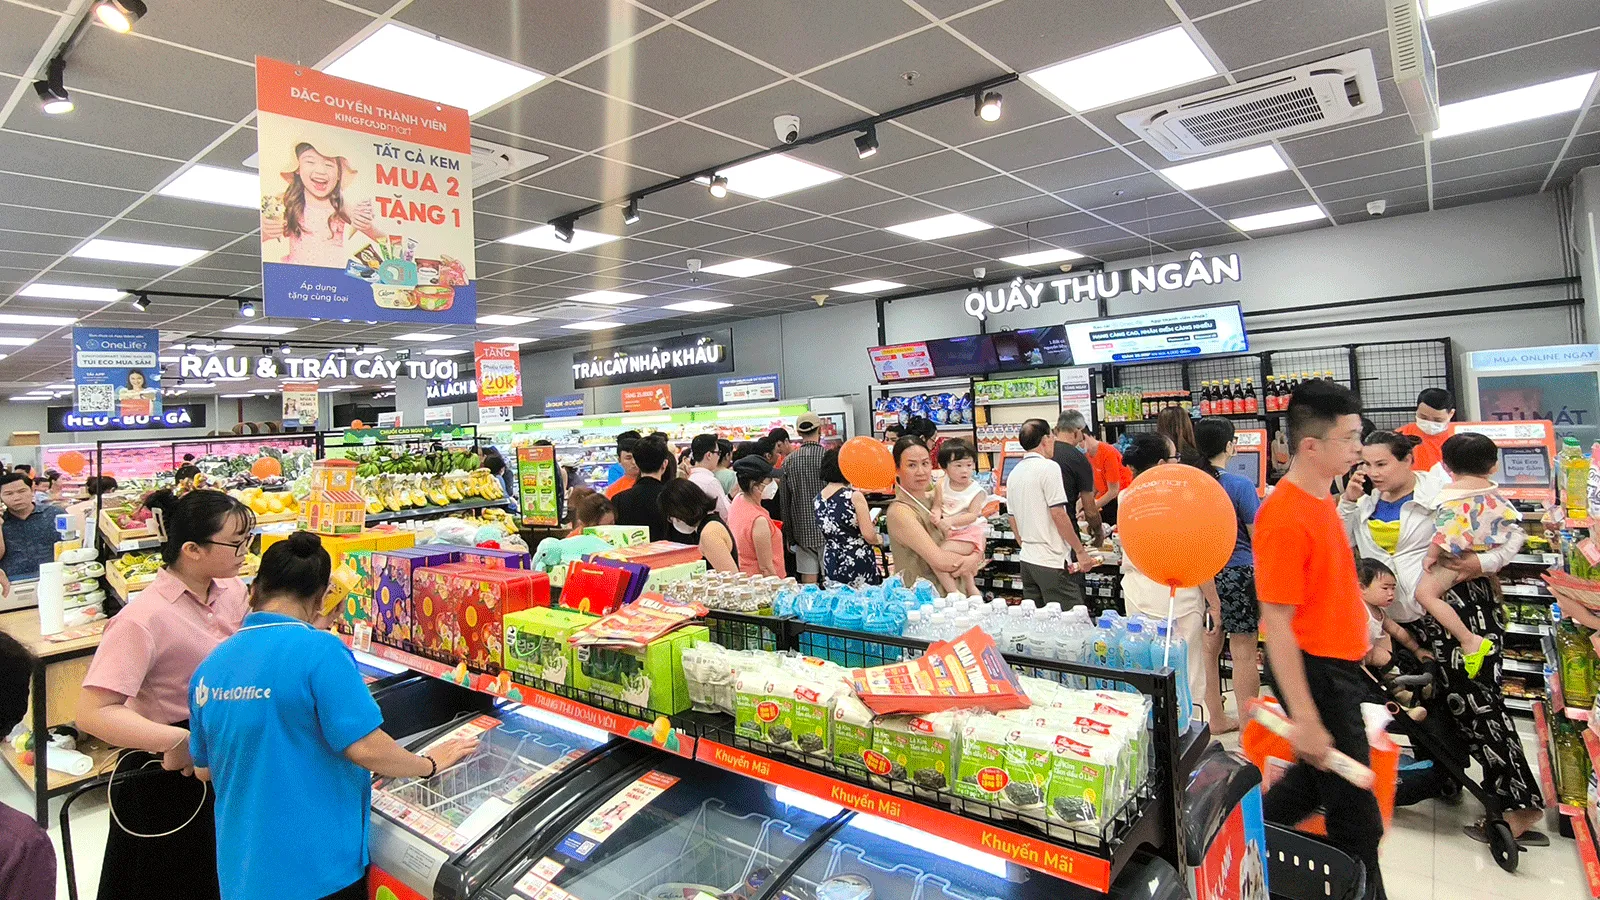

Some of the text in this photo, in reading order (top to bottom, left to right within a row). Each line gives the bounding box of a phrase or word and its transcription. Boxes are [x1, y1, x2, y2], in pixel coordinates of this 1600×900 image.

[290, 86, 447, 132] ĐẶC QUYỀN THÀNH VIÊN
[373, 143, 460, 171] TẤT CẢ KEM
[375, 164, 460, 197] MUA 2
[375, 194, 461, 227] TẶNG 1
[288, 291, 349, 303] tặng cùng loại
[300, 281, 337, 295] Áp dụng
[964, 251, 1242, 320] QUẦY THU NGÂN
[101, 341, 148, 349] OneLife?
[573, 338, 719, 379] TRÁI CÂY NHẬP KHẨU
[1494, 351, 1594, 363] MUA ONLINE NGAY
[181, 351, 458, 381] RAU & TRÁI CÂY TƯƠI
[427, 380, 440, 399] XÀ
[441, 379, 467, 397] LÁCH
[165, 408, 191, 424] GÀ
[535, 694, 617, 729] TRUNG THU ĐOÀN VIÊN
[715, 748, 770, 776] Khuyến Mãi
[831, 786, 901, 817] Khuyến Mãi
[981, 830, 1074, 874] Khuyến Mãi
